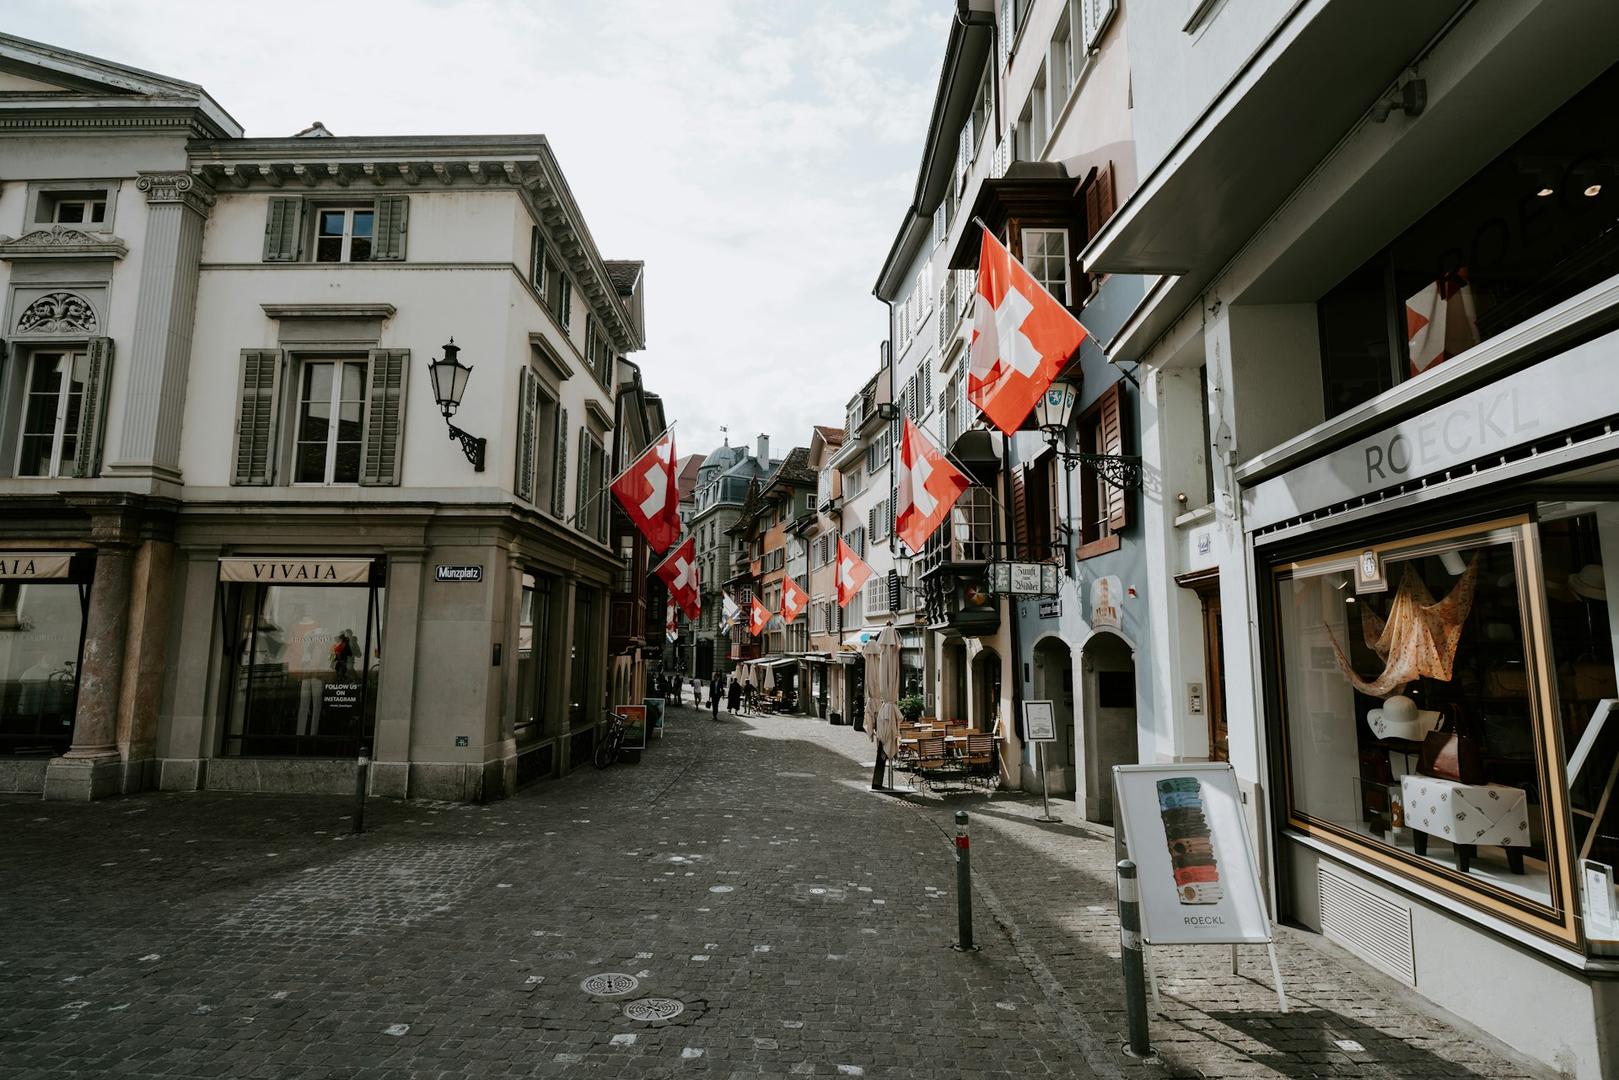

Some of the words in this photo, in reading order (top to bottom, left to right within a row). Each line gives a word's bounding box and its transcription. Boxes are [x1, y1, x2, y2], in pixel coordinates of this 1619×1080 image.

[1365, 387, 1540, 484] ROECKL
[253, 564, 337, 579] VIVAIA
[438, 566, 479, 581] Münzplatz
[1184, 916, 1225, 925] ROECKL
